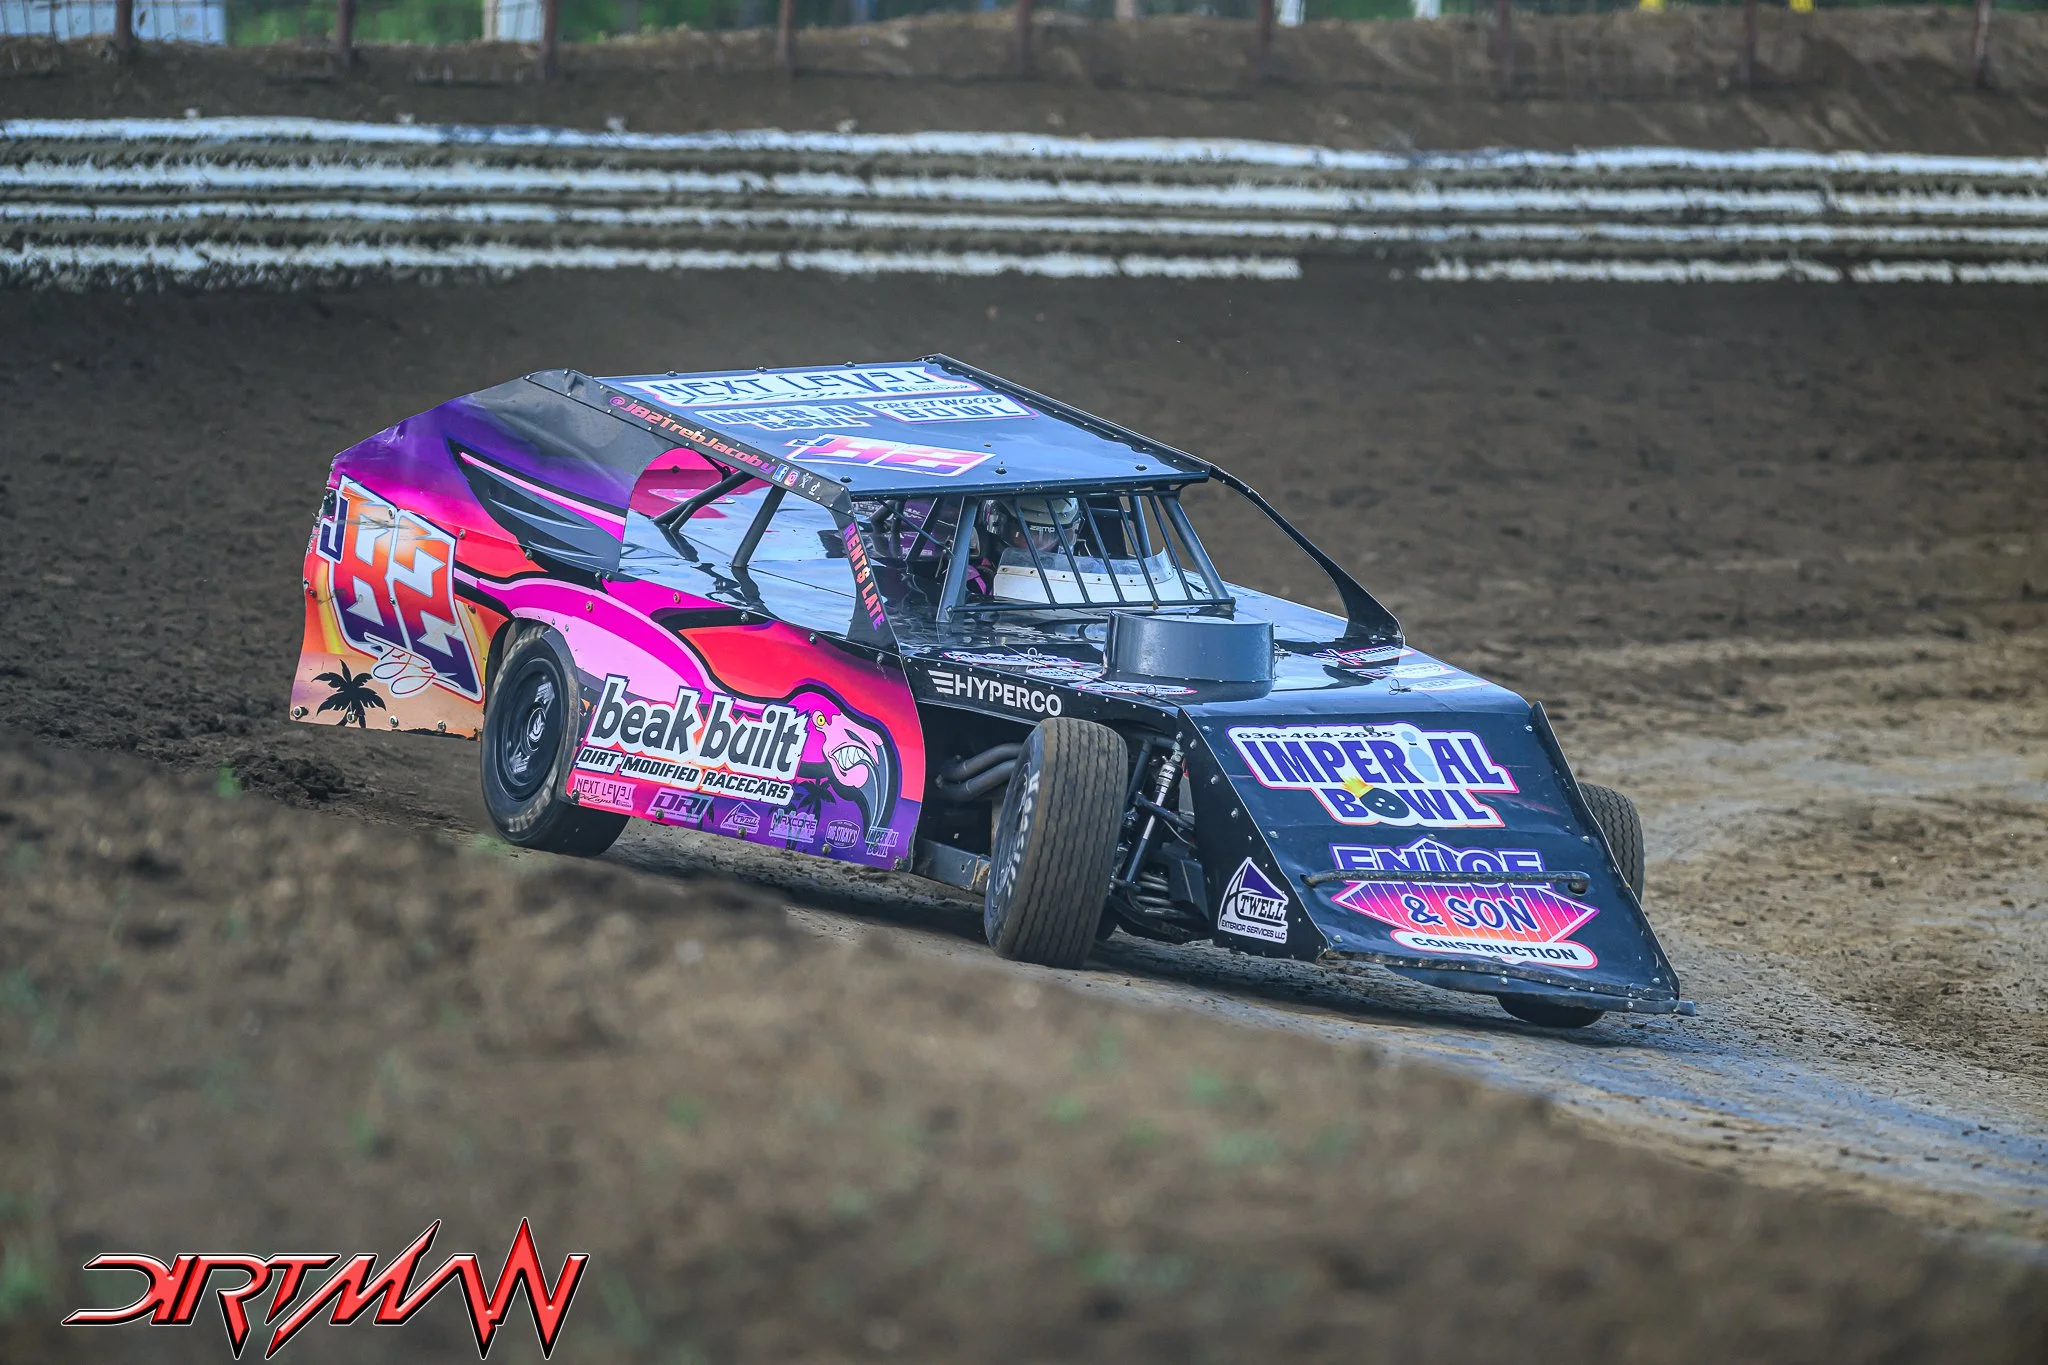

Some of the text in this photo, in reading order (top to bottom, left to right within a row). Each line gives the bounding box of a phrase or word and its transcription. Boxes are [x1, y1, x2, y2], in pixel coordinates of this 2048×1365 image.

[650, 379, 773, 404] NEXT
[778, 371, 934, 392] LEVEL
[873, 396, 1002, 410] CRESTWOOD
[895, 405, 1020, 418] BOWL
[609, 396, 776, 474] @J82TrebJacoby
[861, 580, 885, 631] LATE
[954, 674, 1062, 716] HYPERCO
[592, 682, 800, 772] beak built
[576, 778, 600, 794] NEXT
[579, 748, 791, 799] DIRT MODIFIED RACECARS
[1320, 787, 1491, 820] BOWL
[1221, 919, 1286, 940] EXTERIOR SERVICES LLC
[1403, 896, 1538, 932] & SON
[1411, 936, 1579, 961] CONSTRUCTION
